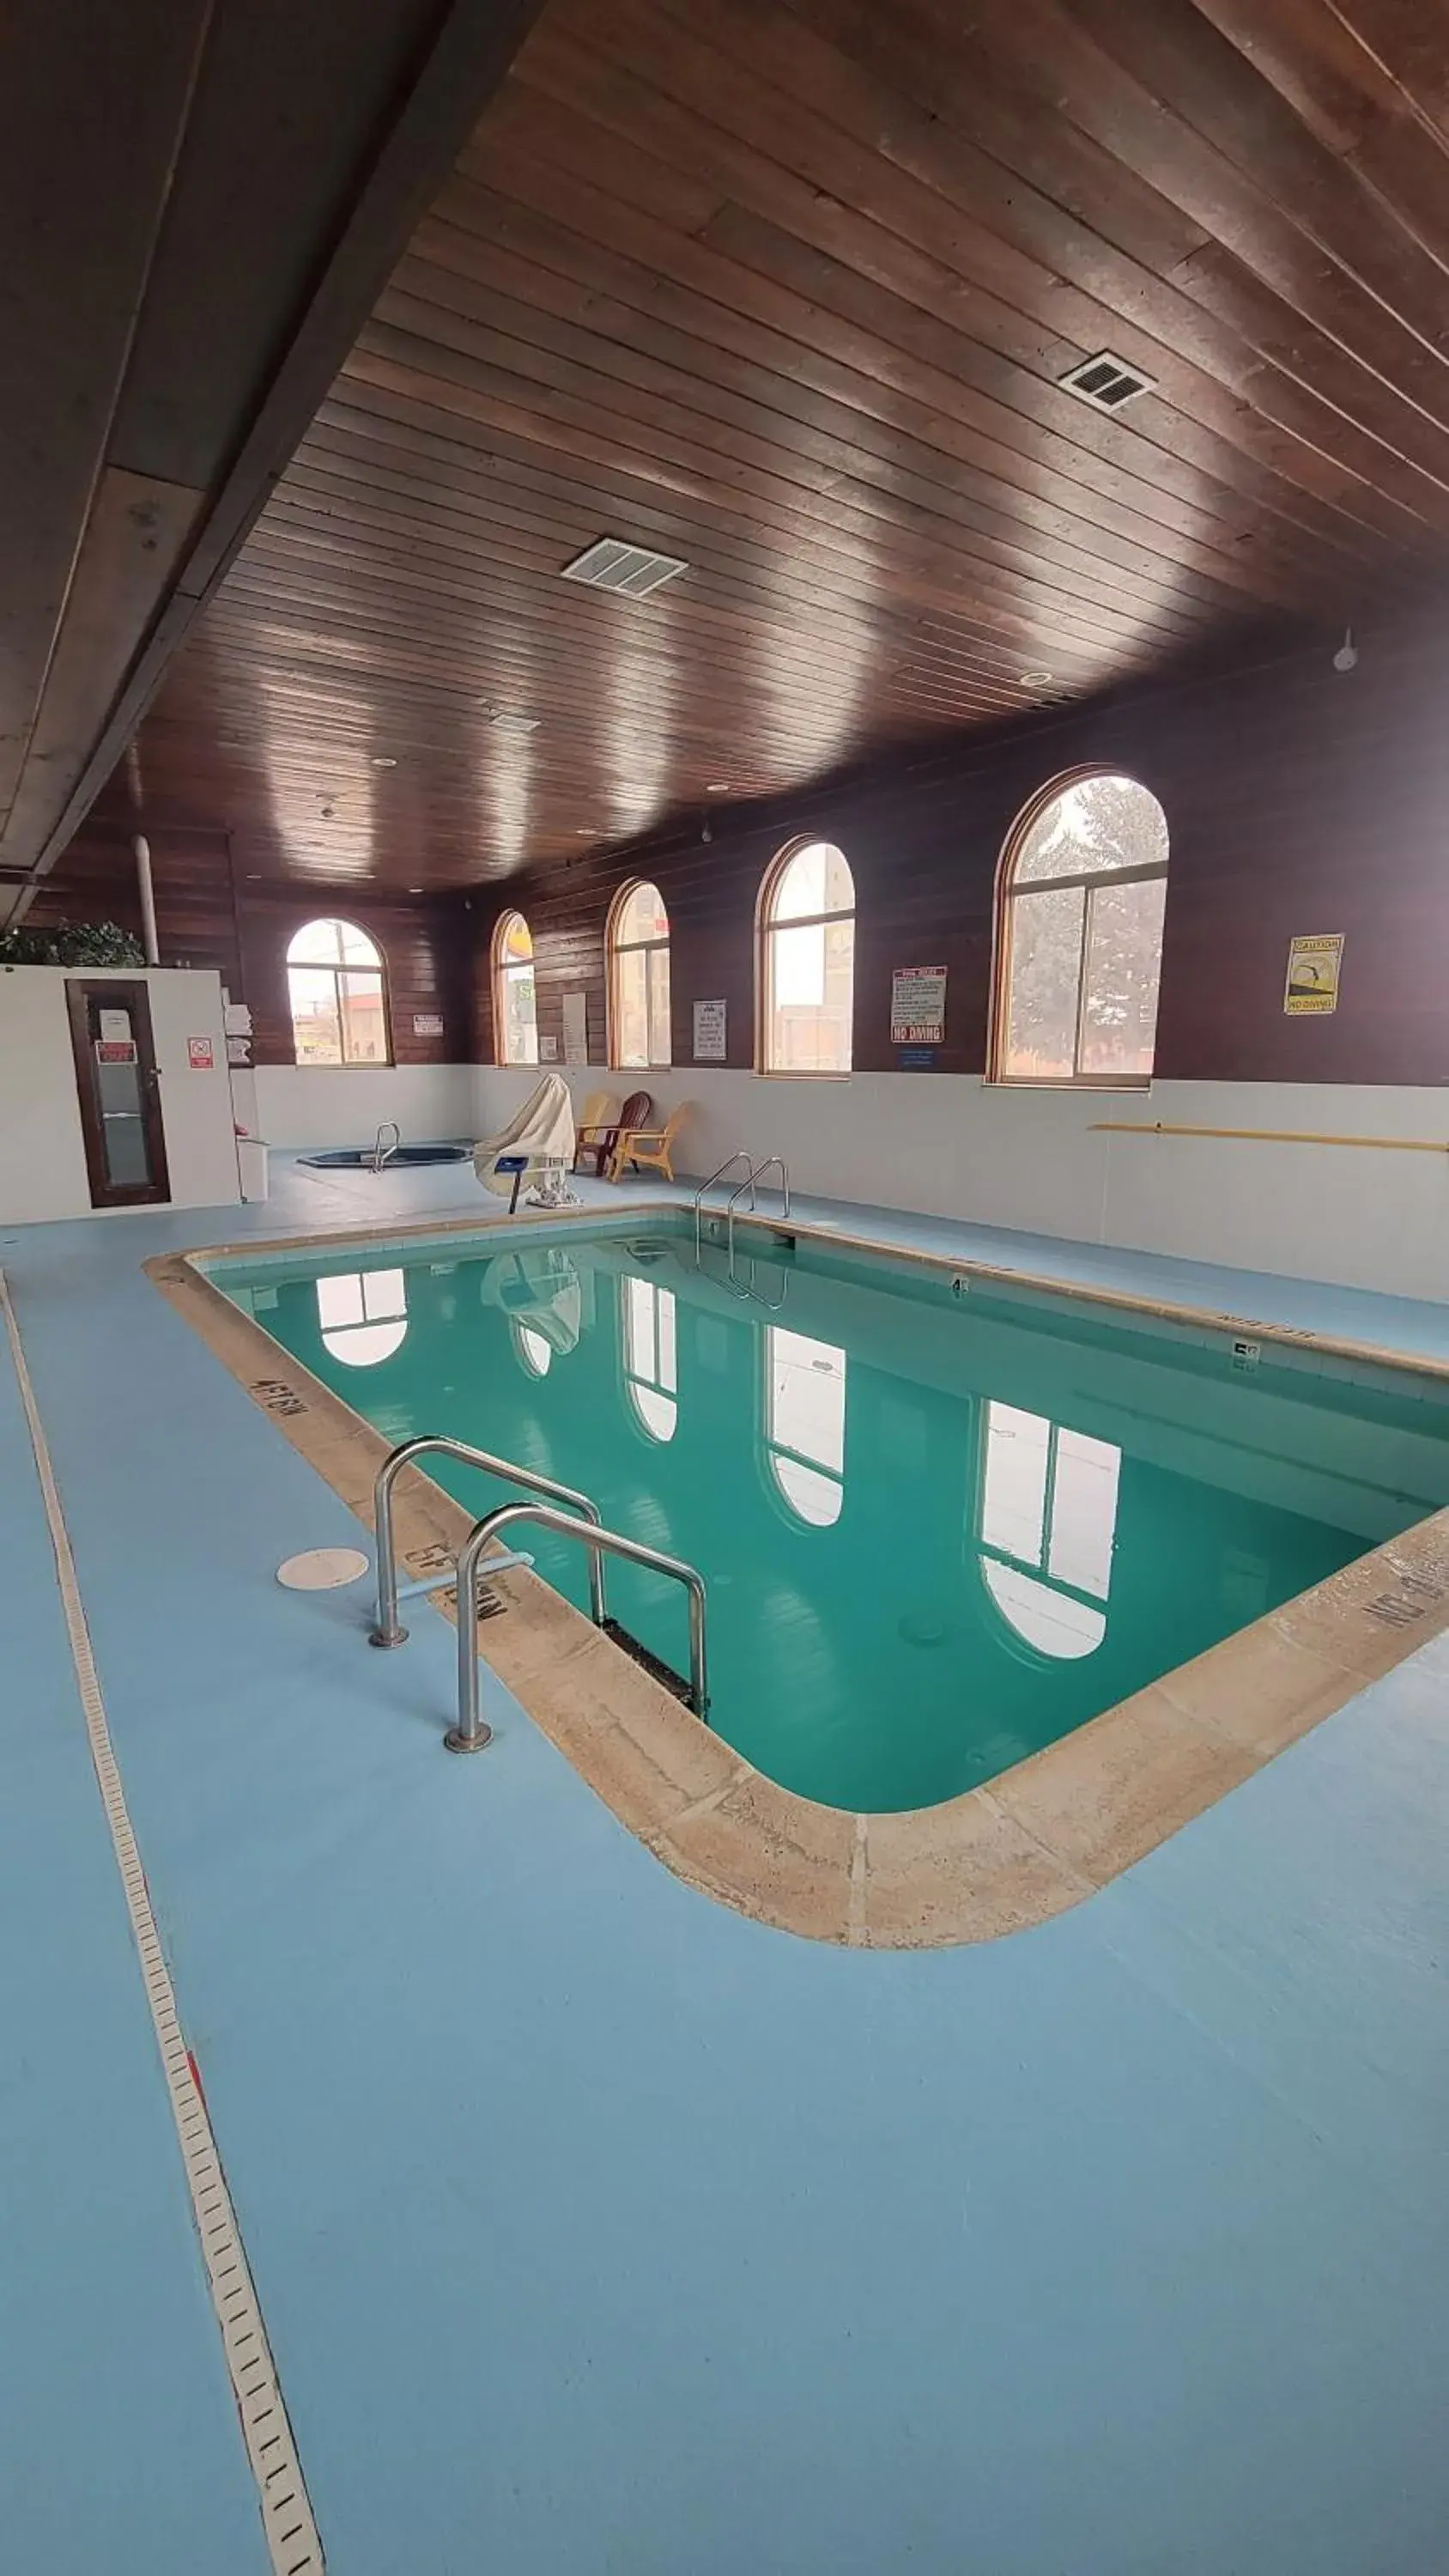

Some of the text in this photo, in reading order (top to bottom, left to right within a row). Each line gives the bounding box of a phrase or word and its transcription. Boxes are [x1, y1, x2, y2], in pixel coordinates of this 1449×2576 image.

[1294, 939, 1338, 950] CAUTION
[894, 1025, 940, 1040] NO DIVING
